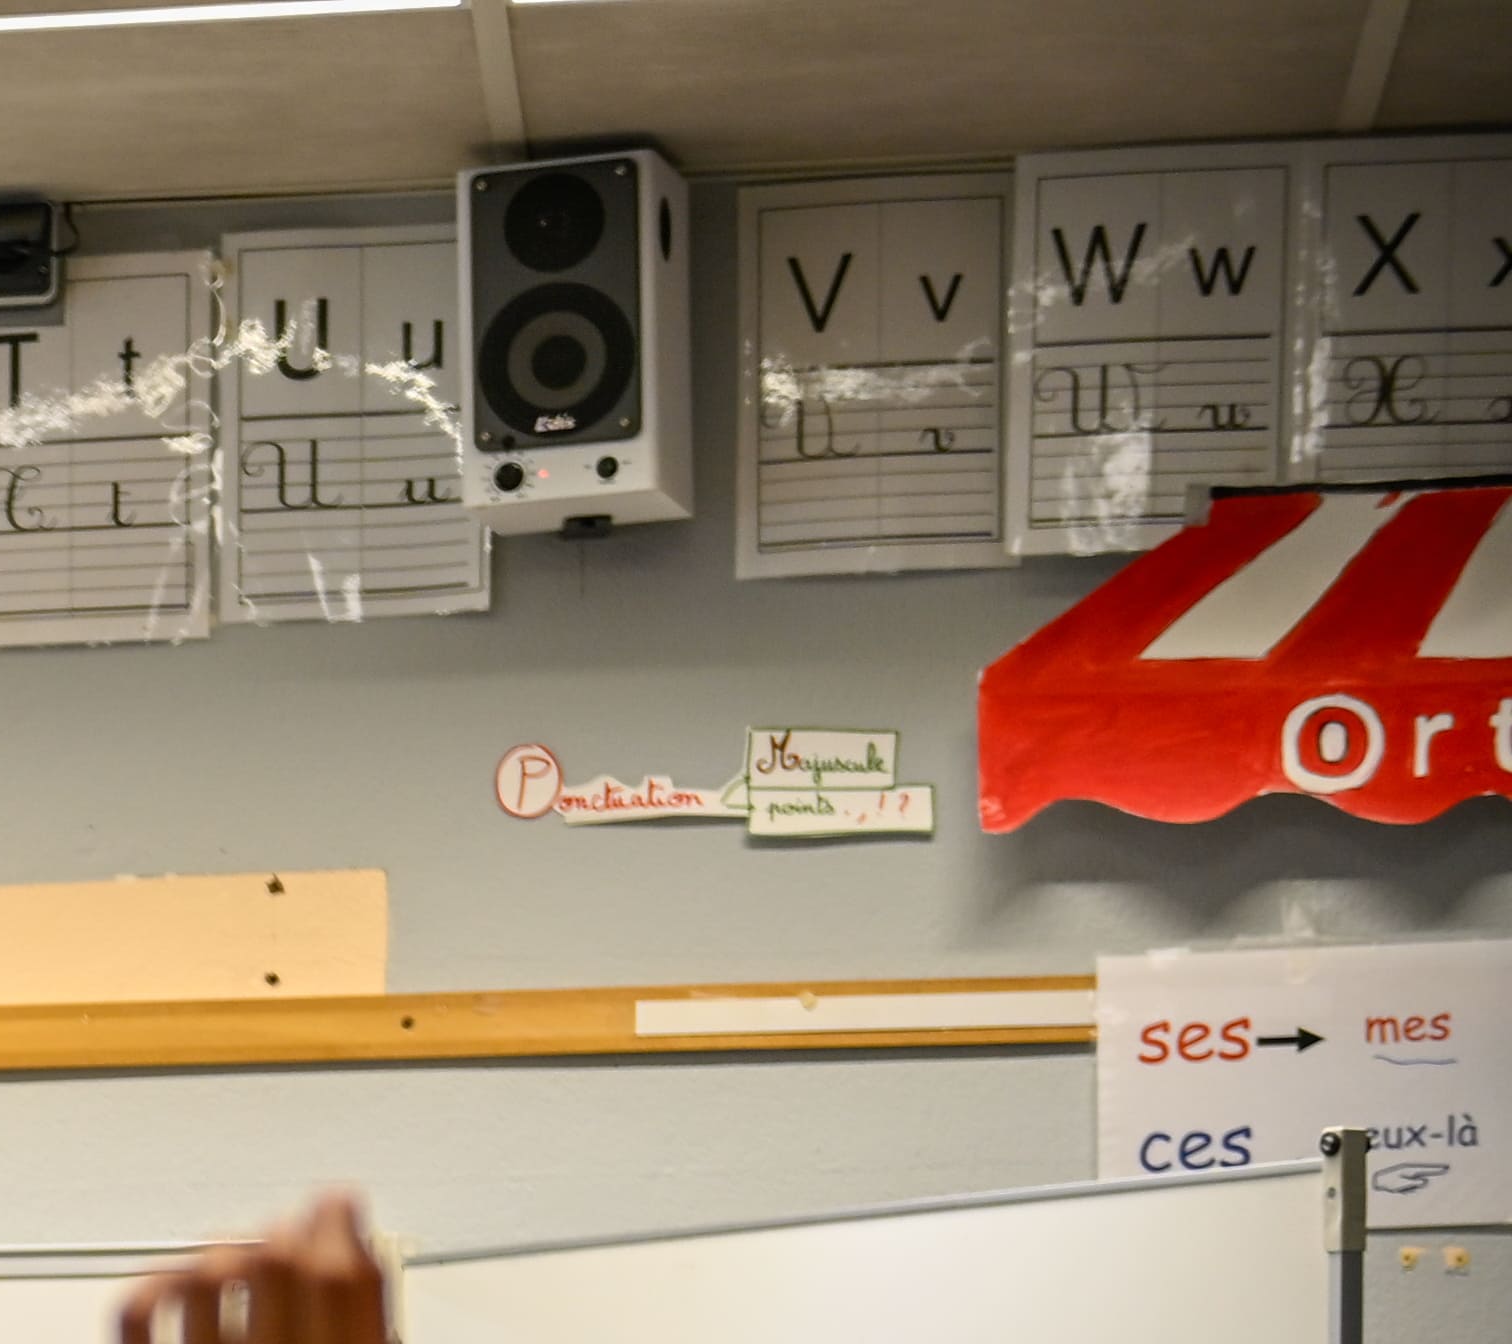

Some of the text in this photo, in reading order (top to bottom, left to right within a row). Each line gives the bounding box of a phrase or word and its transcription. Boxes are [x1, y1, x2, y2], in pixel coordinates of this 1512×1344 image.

[1050, 221, 1257, 307] W w
[1354, 210, 1423, 296] X
[786, 251, 964, 333] V v
[117, 336, 142, 386] t
[274, 296, 445, 381] U u
[519, 755, 704, 813] Ponctuation
[756, 730, 889, 784] Majuscule
[768, 795, 836, 822] points
[1138, 1012, 1451, 1065] ses mes
[1138, 1114, 1479, 1174] ces eux-là
